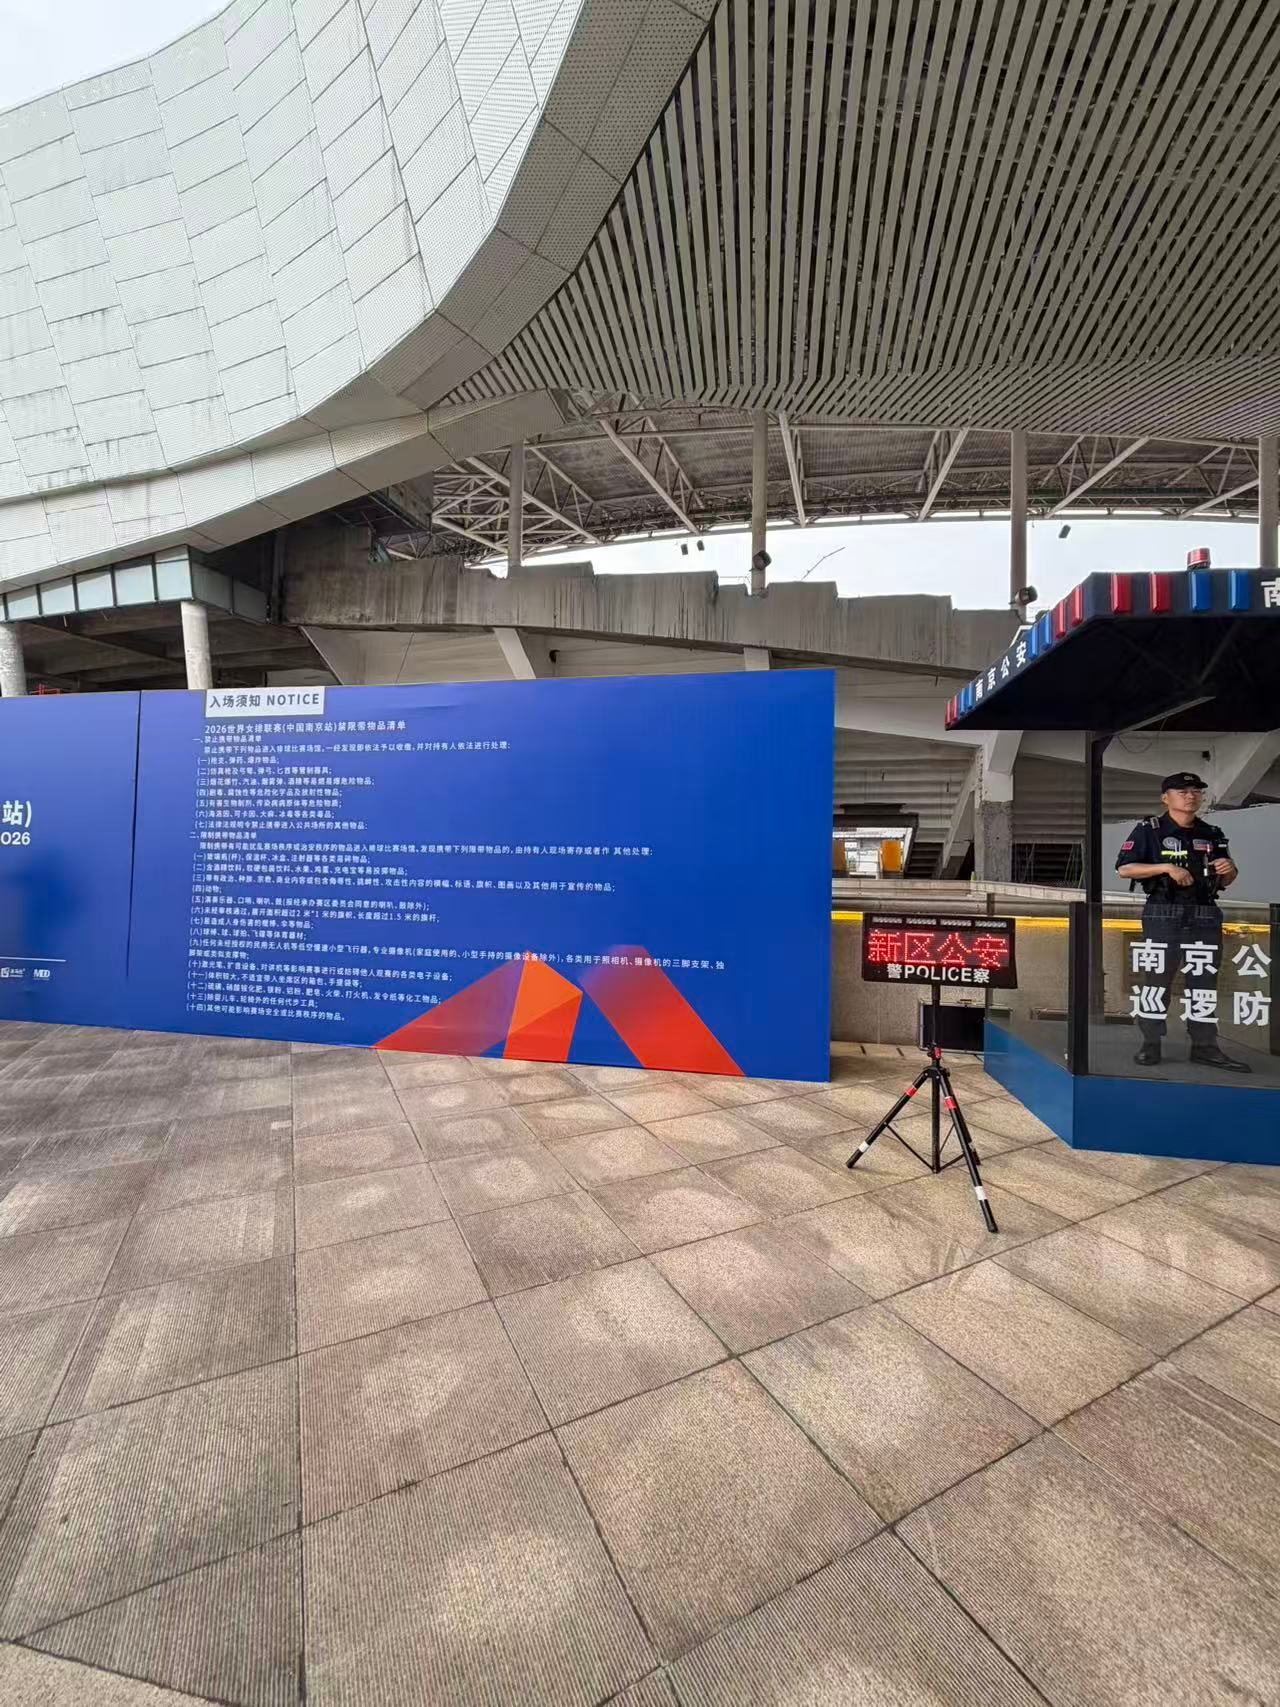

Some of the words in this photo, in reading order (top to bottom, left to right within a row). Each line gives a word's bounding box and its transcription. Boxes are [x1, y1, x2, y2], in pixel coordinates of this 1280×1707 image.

[975, 640, 1027, 701] 南京公安
[209, 694, 261, 708] 入场须知
[266, 693, 320, 706] NOTICE
[2, 799, 32, 828] 站)
[868, 929, 1008, 967] 新区公安
[886, 963, 990, 984] 警POLICE察
